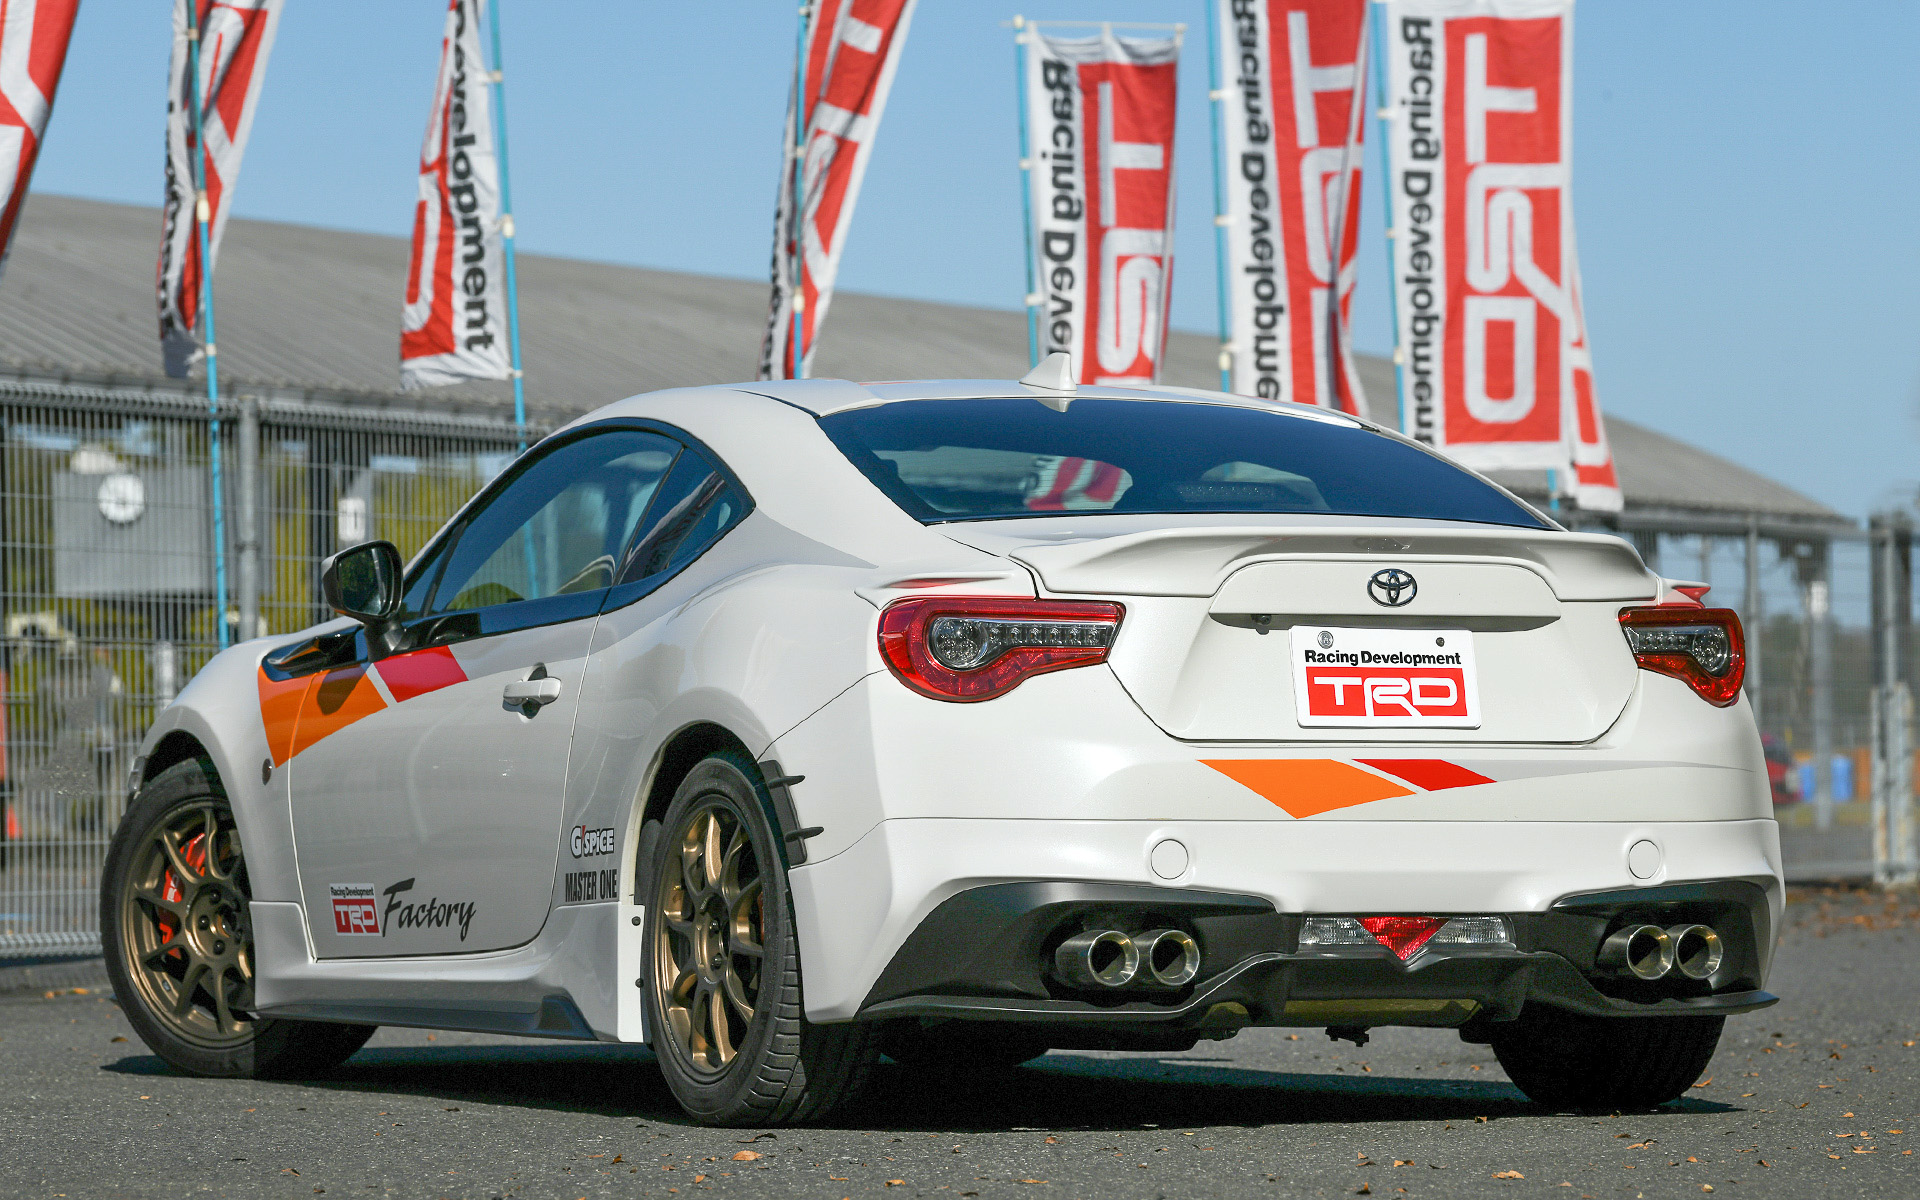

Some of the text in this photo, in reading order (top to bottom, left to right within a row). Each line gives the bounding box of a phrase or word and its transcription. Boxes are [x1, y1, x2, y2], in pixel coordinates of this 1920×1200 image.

[1304, 650, 1462, 667] Racing Development
[1313, 676, 1459, 716] TRD
[330, 886, 375, 898] Racing Development
[565, 869, 618, 902] MASTER ONE
[334, 877, 477, 942] TRD Factory
